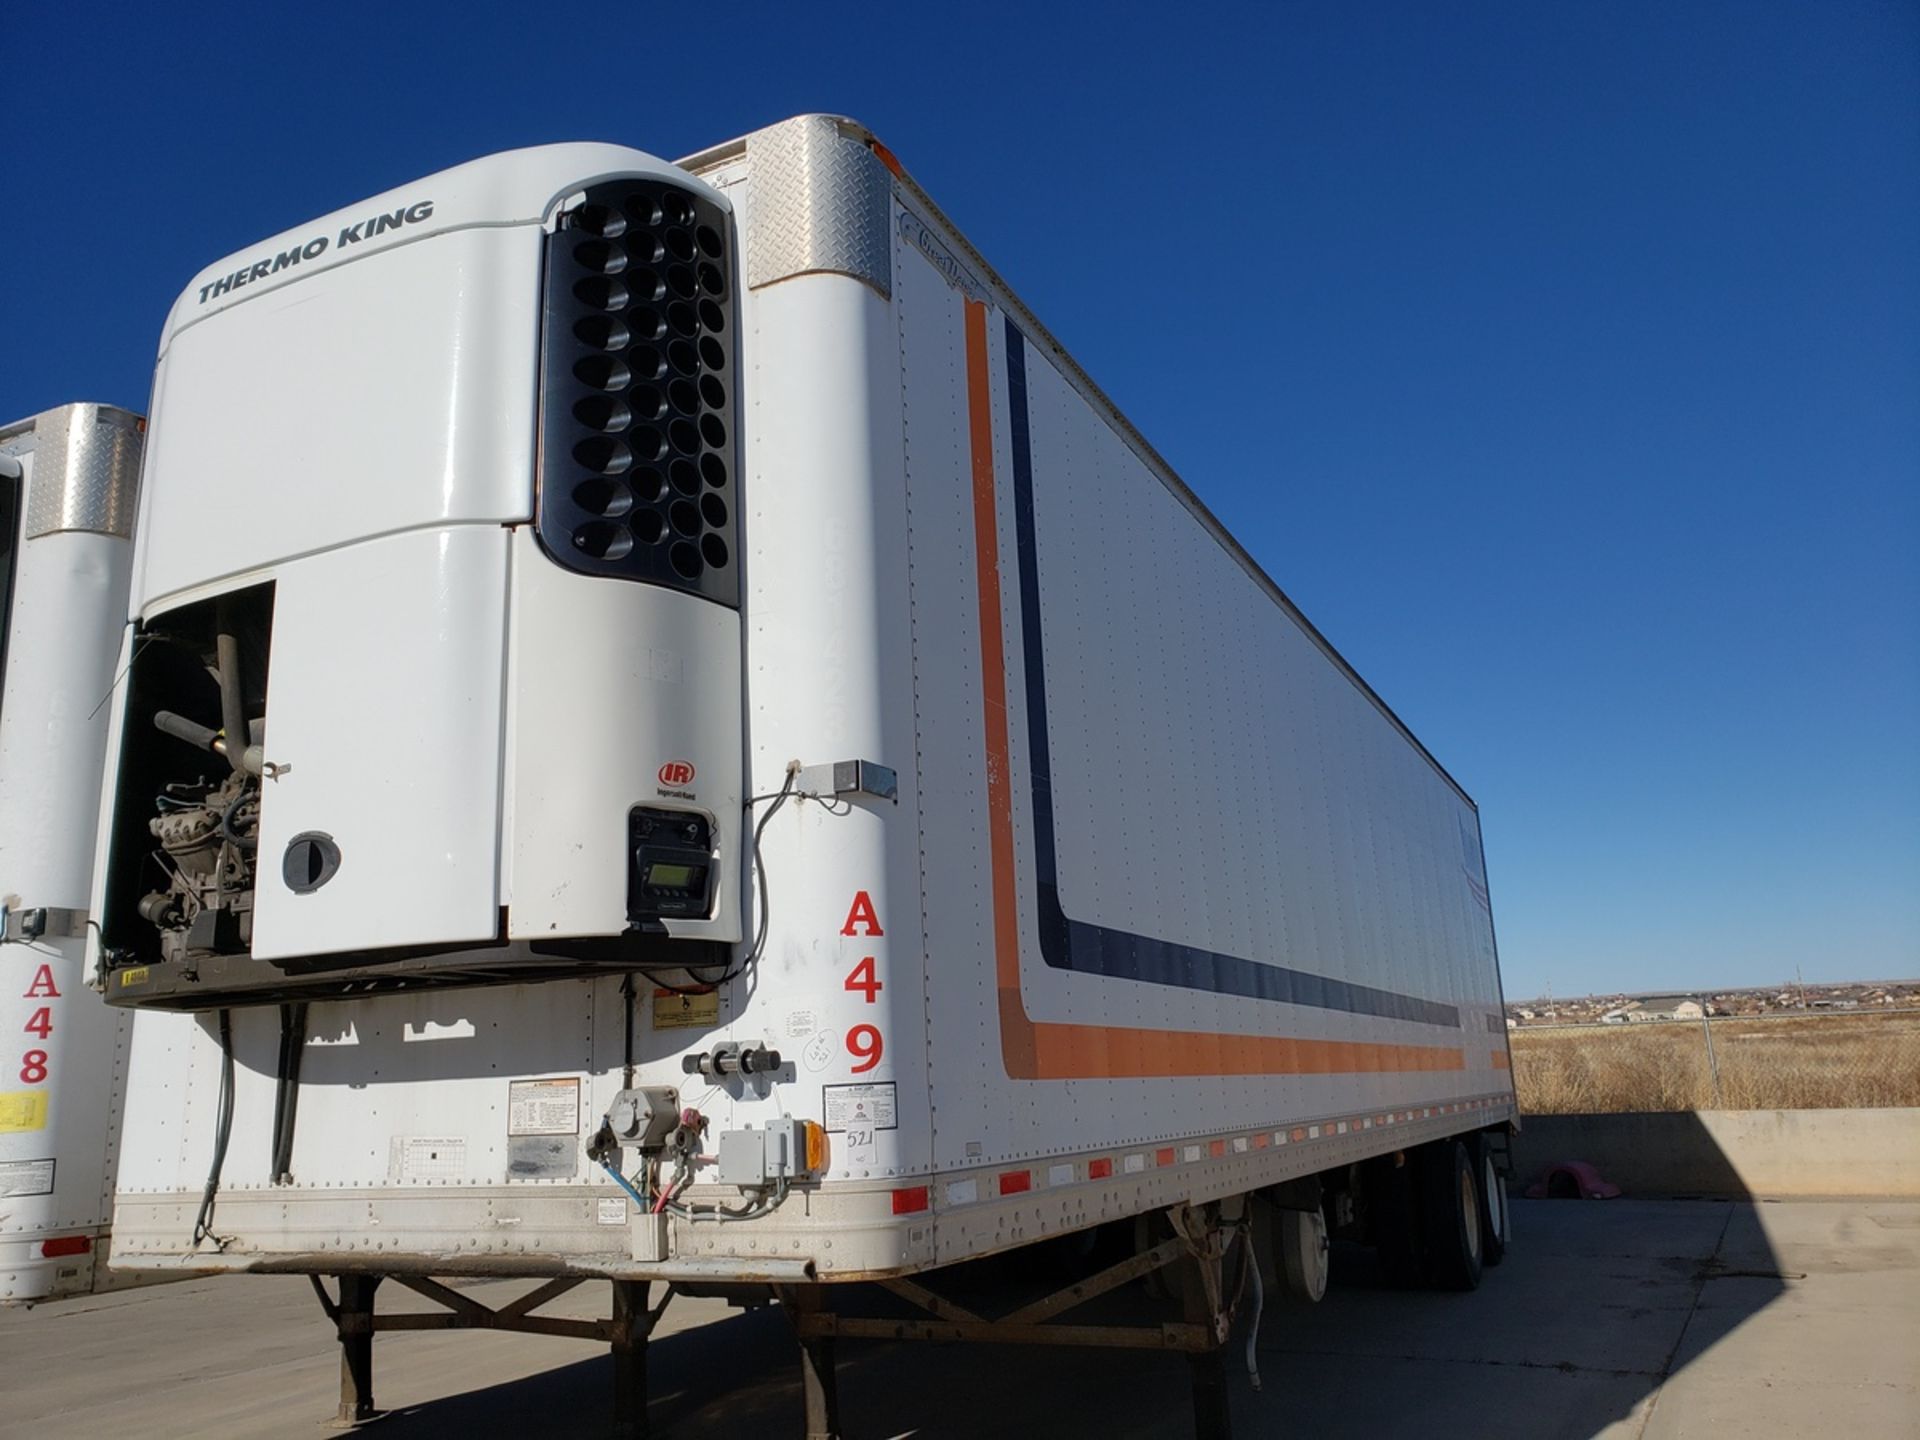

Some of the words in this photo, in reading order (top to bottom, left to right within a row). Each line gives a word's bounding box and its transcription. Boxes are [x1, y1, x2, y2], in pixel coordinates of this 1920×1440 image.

[199, 237, 329, 305] THERMO
[336, 200, 434, 249] KING
[664, 763, 689, 784] IR
[847, 1130, 873, 1148] 521
